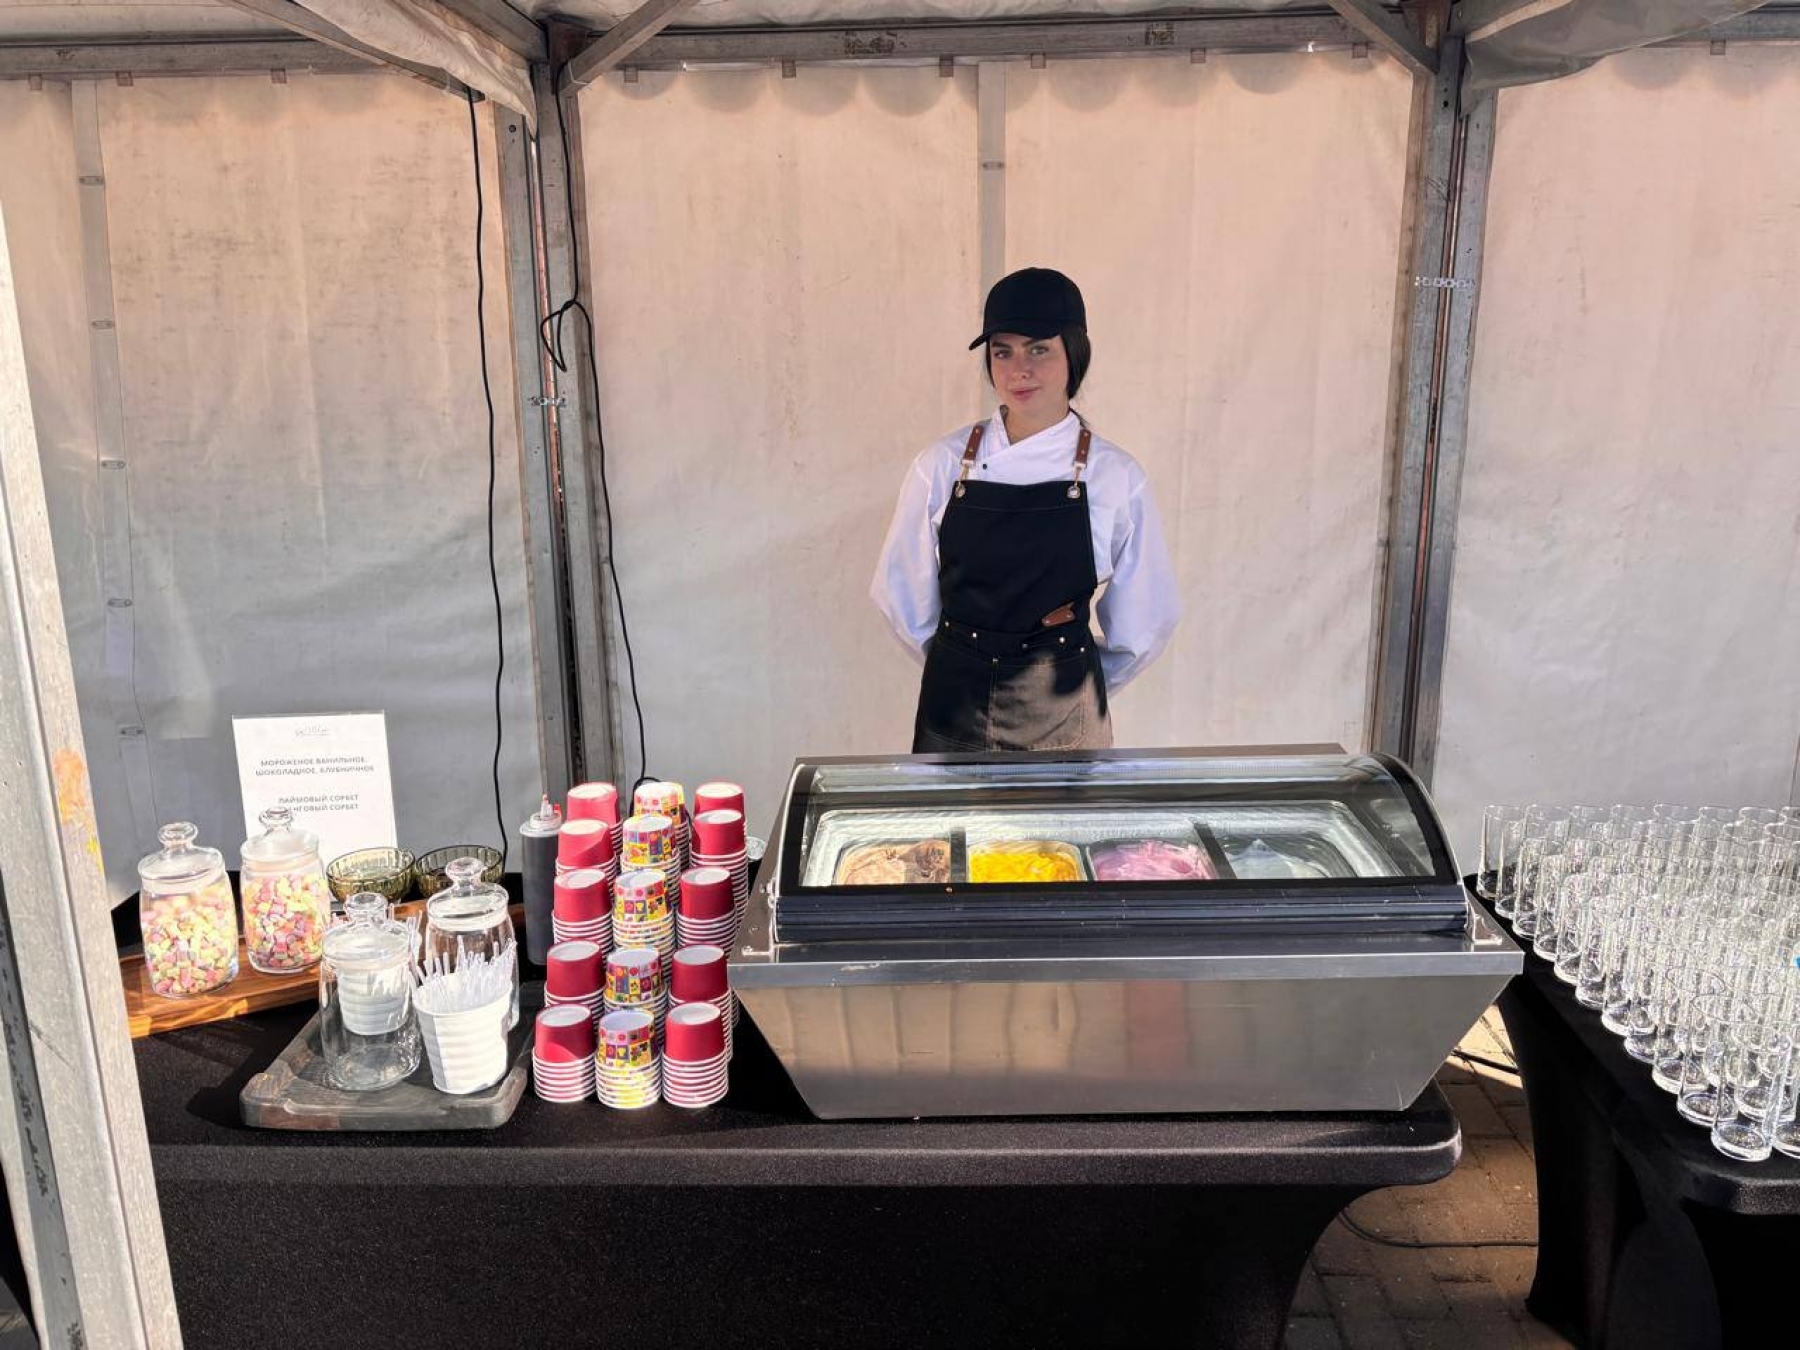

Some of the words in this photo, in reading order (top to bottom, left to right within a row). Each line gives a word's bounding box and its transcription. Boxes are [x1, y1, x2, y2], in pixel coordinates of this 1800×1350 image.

[260, 758, 314, 767] МОРОЖЕНОЕ
[320, 764, 374, 773] КЛУБНИЧНОЕ
[278, 794, 328, 804] ЛАЙМОВЫЙ
[329, 794, 359, 802] СОРБЕТ
[329, 803, 359, 811] СОРБЕТ
